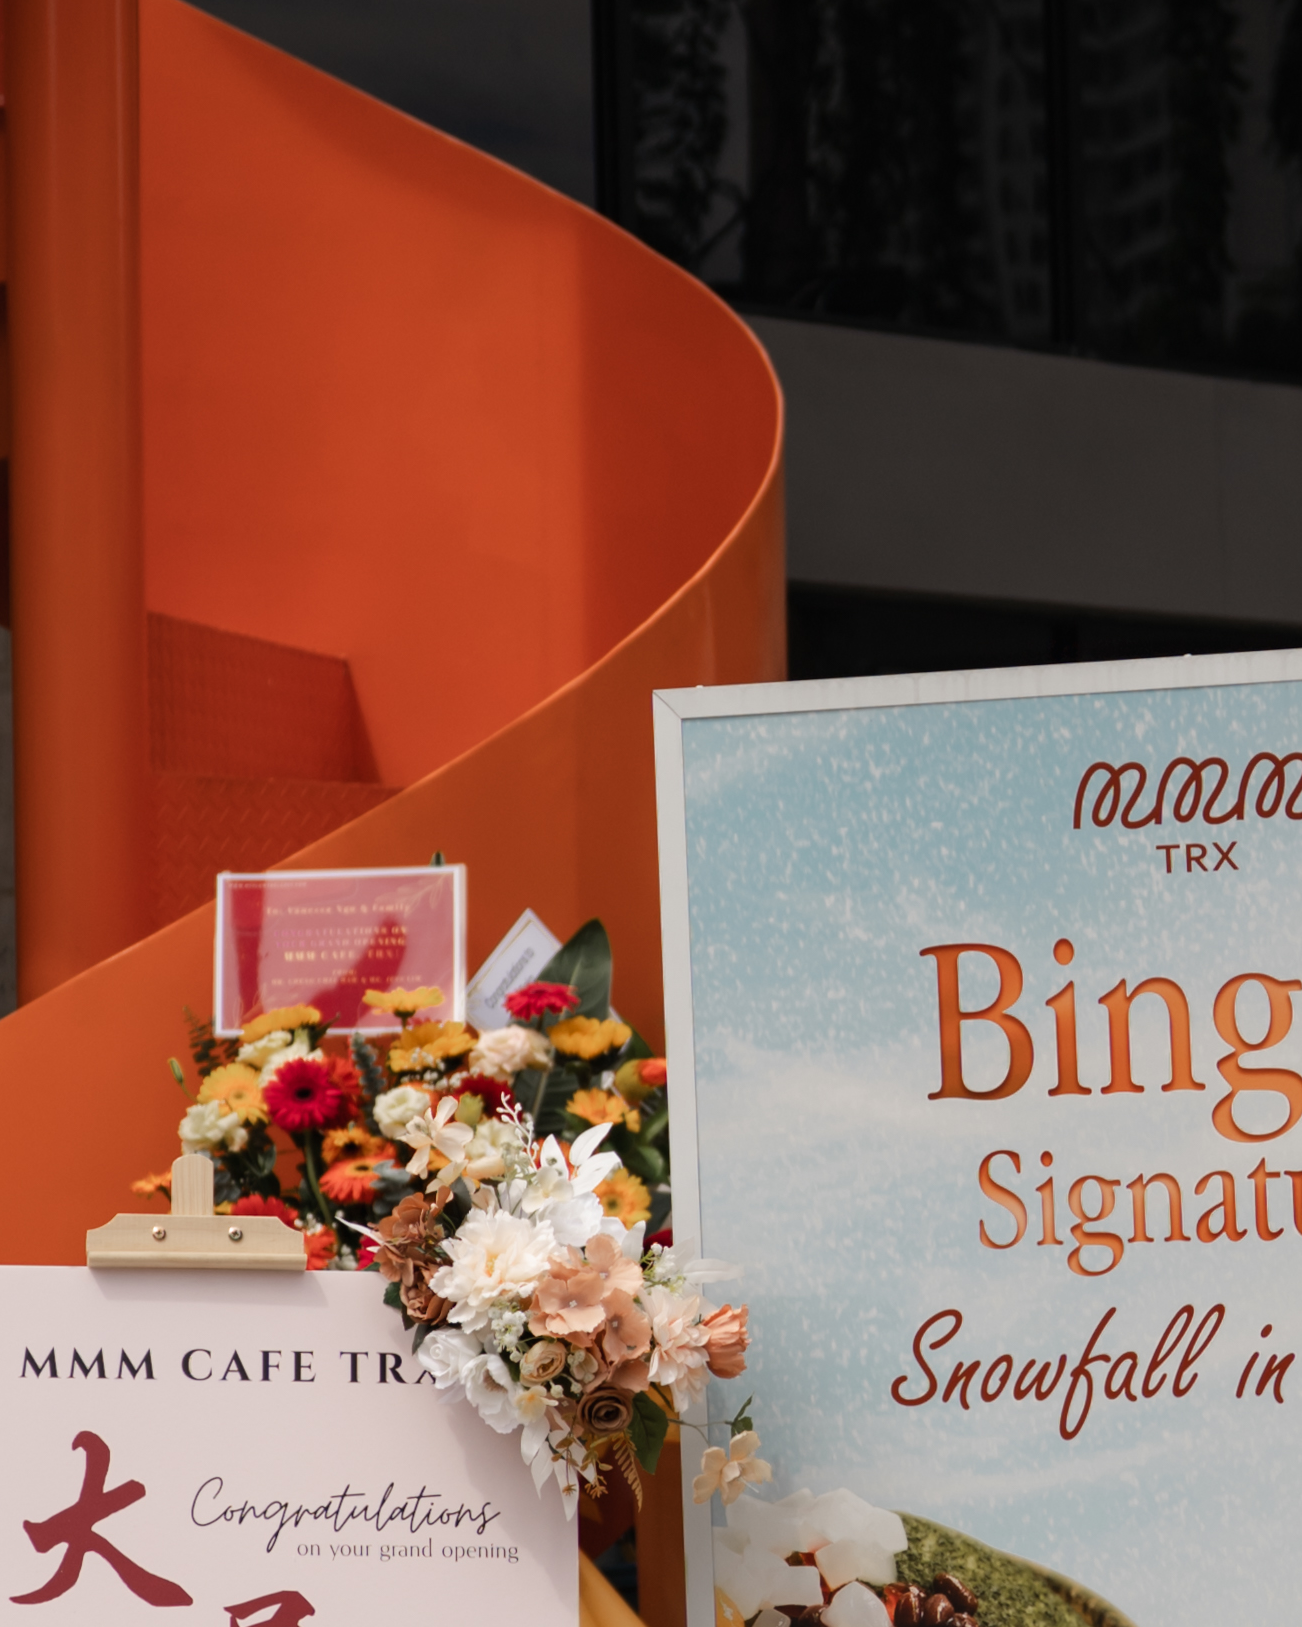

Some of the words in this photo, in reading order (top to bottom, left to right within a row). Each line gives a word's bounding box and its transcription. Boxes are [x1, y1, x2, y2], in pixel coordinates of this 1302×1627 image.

[1156, 841, 1240, 873] TRX
[19, 1347, 157, 1381] MMM
[181, 1348, 316, 1382] CAFE
[891, 1302, 1226, 1441] Snowfall
[1235, 1324, 1296, 1402] in
[191, 1476, 501, 1554] Congratulations
[297, 1543, 321, 1557] on
[330, 1543, 372, 1561] your
[380, 1538, 432, 1562] grand
[441, 1542, 519, 1564] opening
